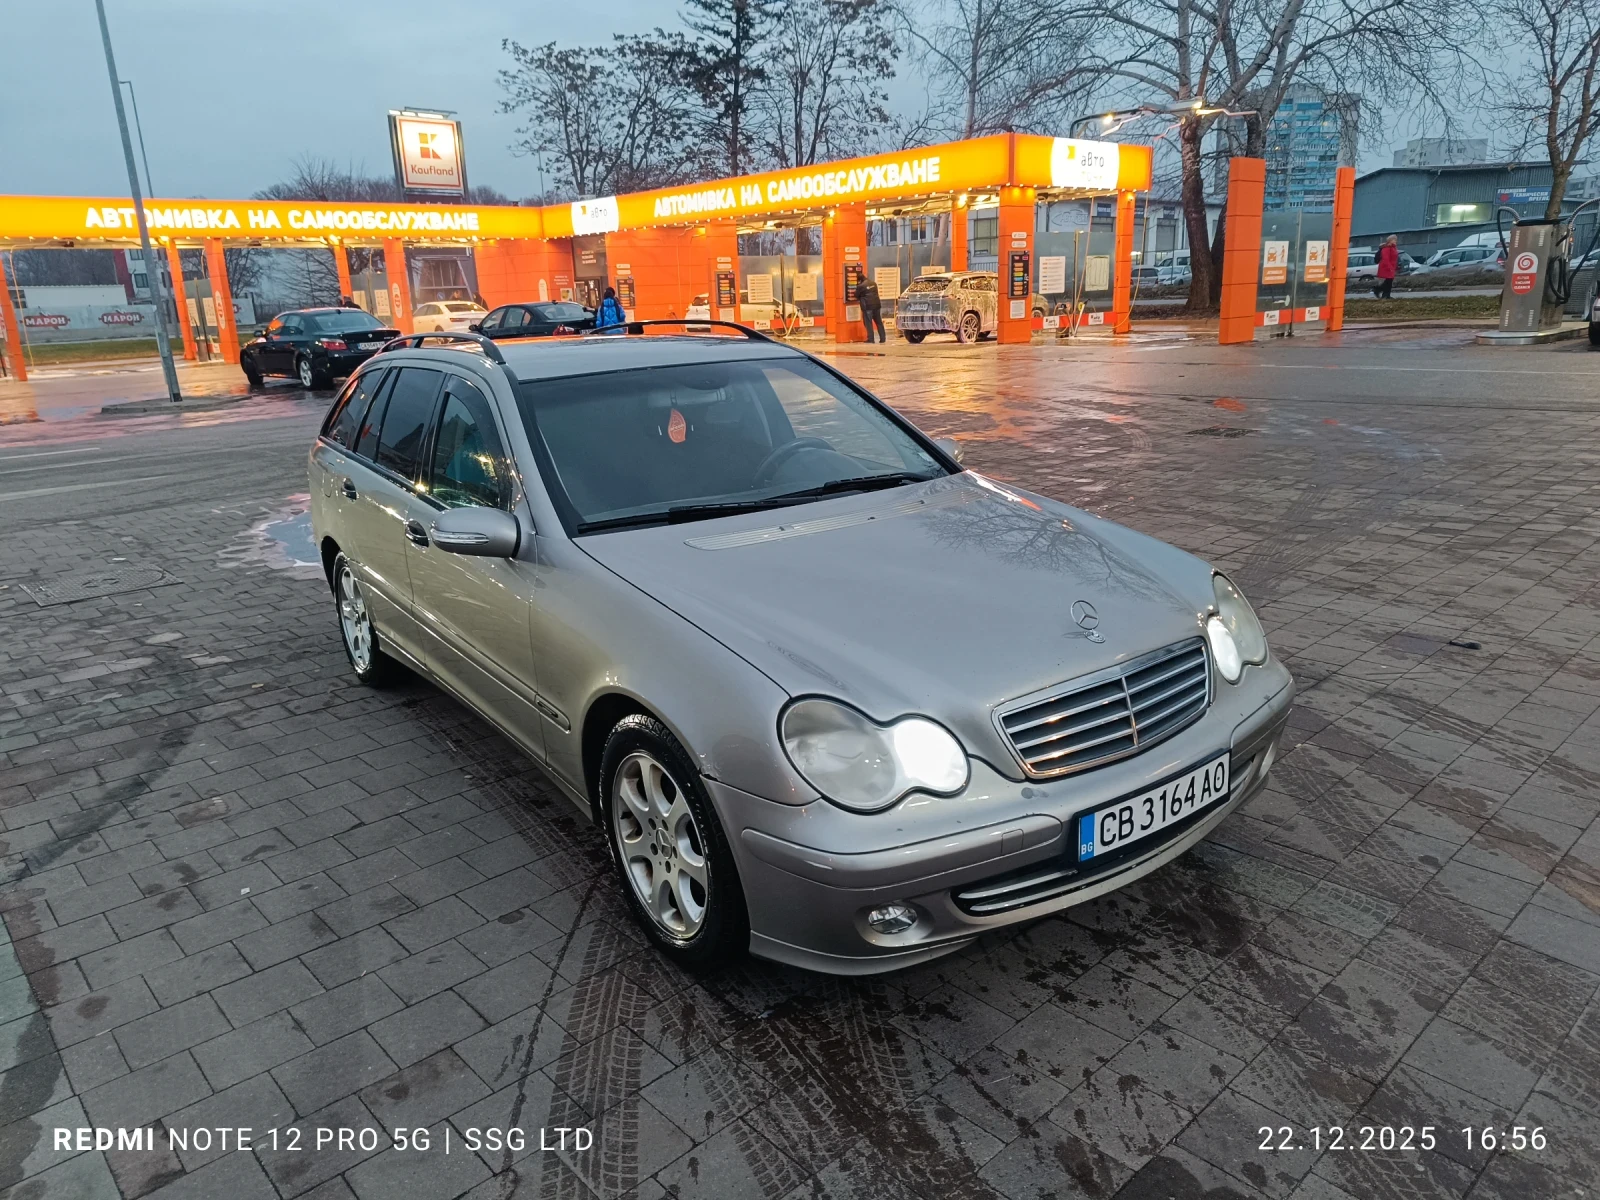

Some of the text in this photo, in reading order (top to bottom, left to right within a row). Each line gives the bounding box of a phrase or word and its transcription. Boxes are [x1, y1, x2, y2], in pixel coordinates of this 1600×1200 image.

[410, 164, 454, 176] Kaufland
[653, 156, 941, 218] АВТОМИВКА НА САМООБСЛУЖВАНЕ
[85, 206, 480, 231] АВТМИВКА НА САМООБСЛУЖВАНЕ
[25, 316, 66, 326] МАРОН
[103, 312, 140, 323] МАРОН
[1100, 761, 1226, 847] CB 3164 AO
[1081, 841, 1094, 855] BG
